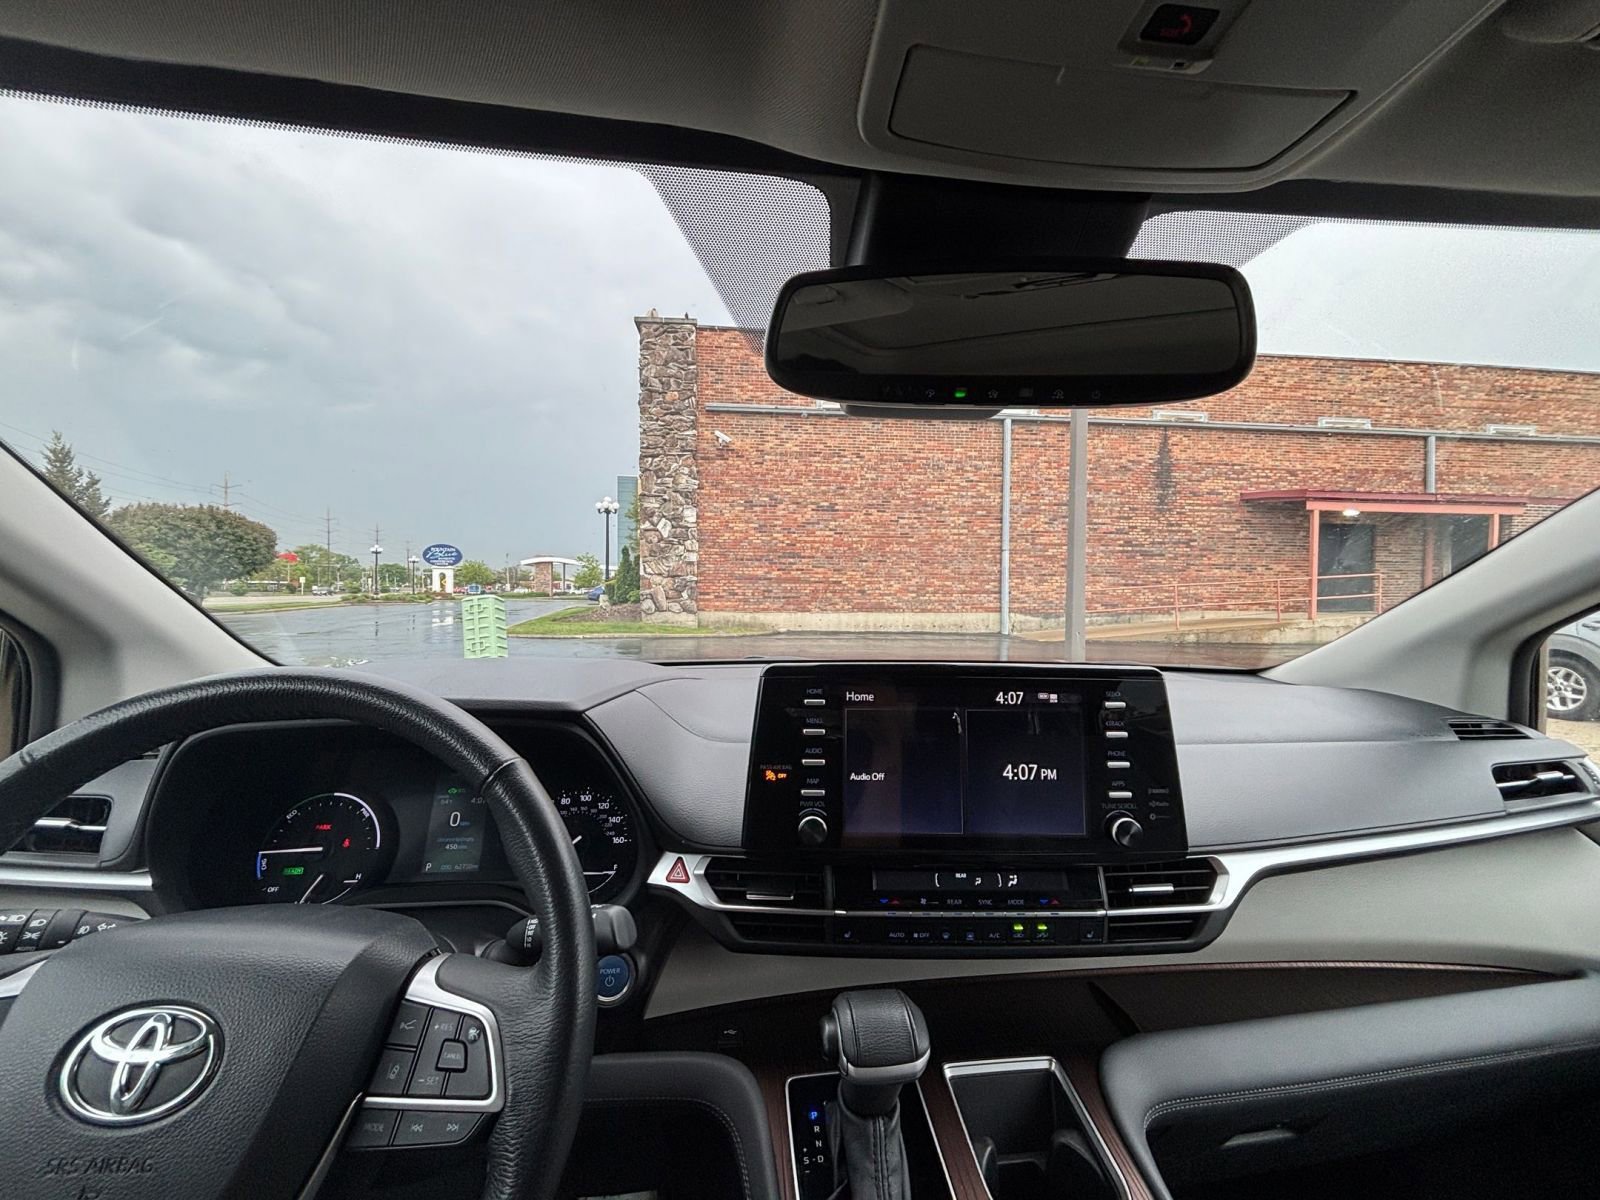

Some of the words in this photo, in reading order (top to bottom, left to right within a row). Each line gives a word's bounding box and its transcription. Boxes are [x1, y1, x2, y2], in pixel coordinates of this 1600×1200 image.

[846, 691, 875, 701] Home
[995, 691, 1024, 704] 4:07
[849, 771, 871, 781] Audio
[872, 771, 886, 781] Off
[1002, 763, 1038, 781] 4:07
[1040, 769, 1058, 781] PM
[560, 797, 571, 805] 80
[580, 794, 592, 802] 100
[598, 802, 610, 810] 120
[285, 809, 298, 820] ECO
[449, 811, 461, 827] 0
[612, 836, 625, 844] 160
[1007, 898, 1025, 906] MODE
[599, 967, 621, 975] POWER
[813, 1125, 821, 1133] R
[815, 1140, 822, 1148] N
[803, 1156, 810, 1165] S
[817, 1155, 824, 1163] D
[83, 1156, 154, 1175] AIRBAG
